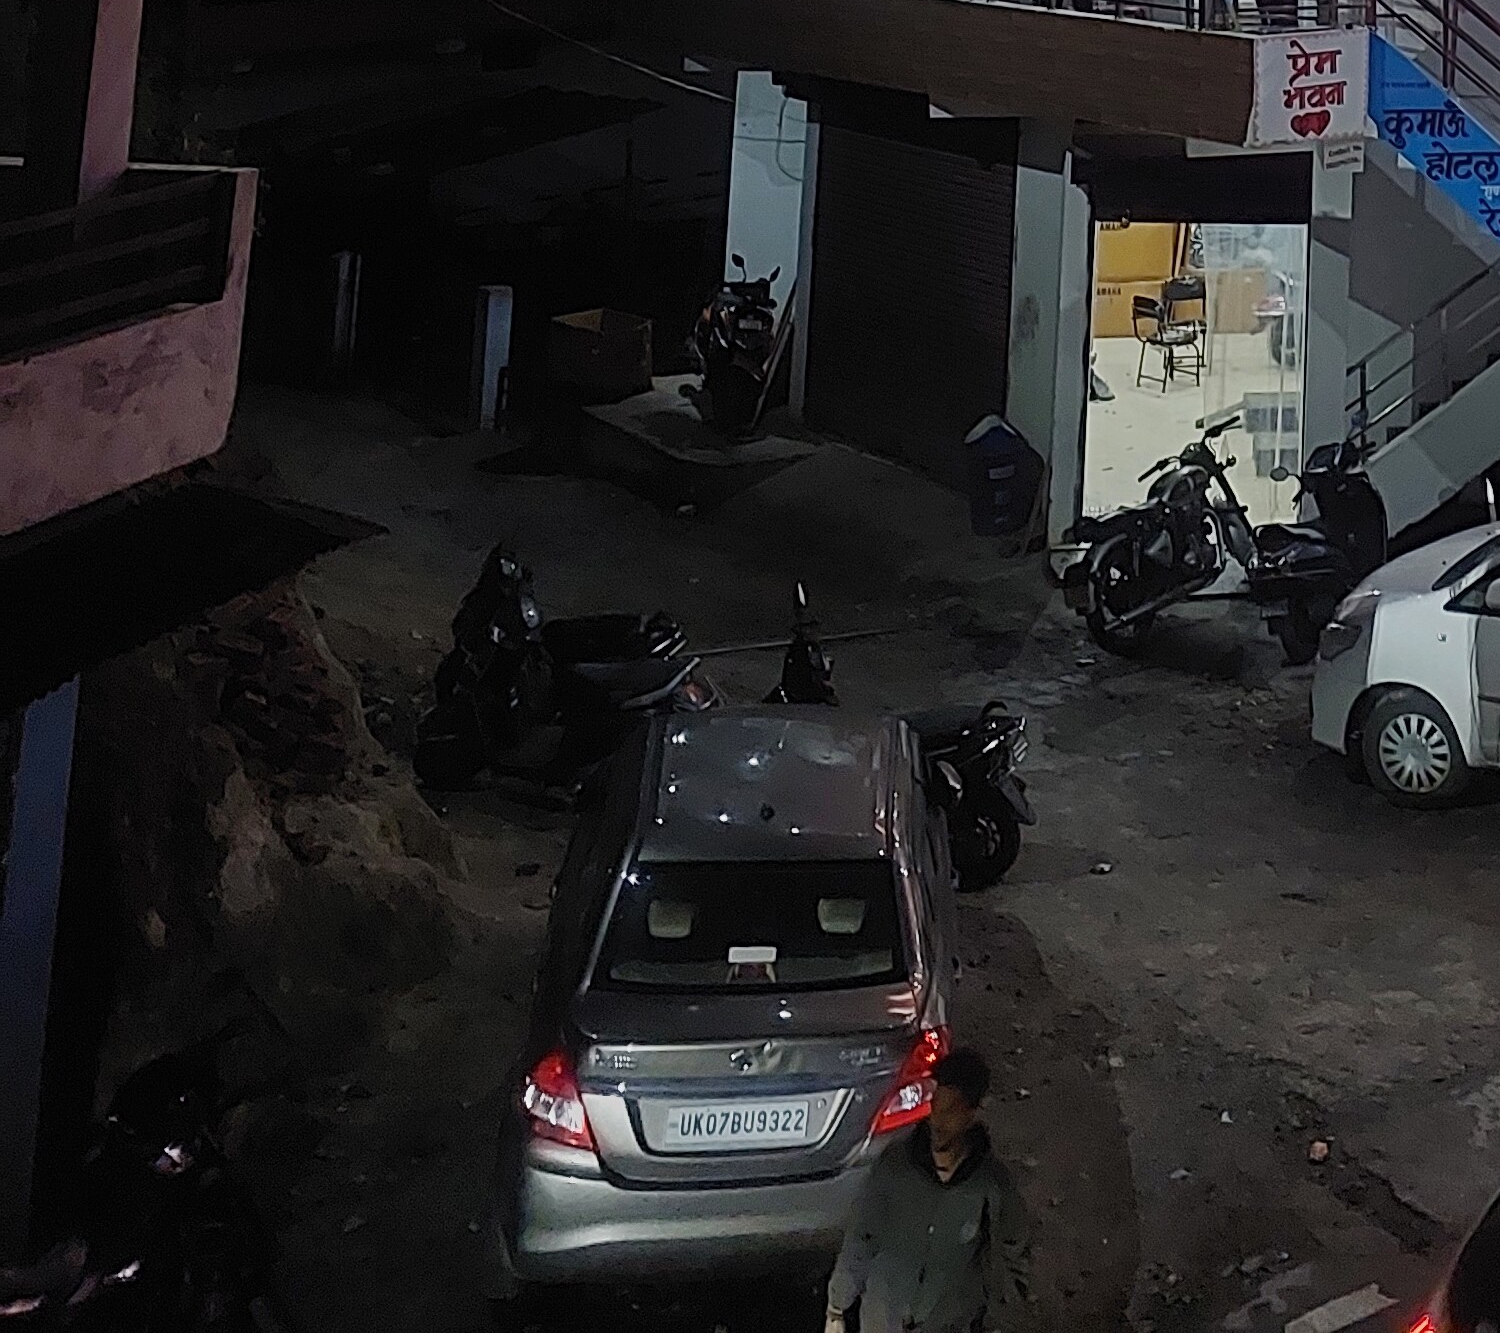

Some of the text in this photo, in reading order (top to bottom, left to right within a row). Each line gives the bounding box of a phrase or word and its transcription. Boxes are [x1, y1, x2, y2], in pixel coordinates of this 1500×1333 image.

[1286, 39, 1342, 87] प्रेम
[1283, 81, 1347, 110] भवन
[1383, 100, 1470, 149] कुमाऊँ
[680, 1109, 804, 1138] UK07BU9322
